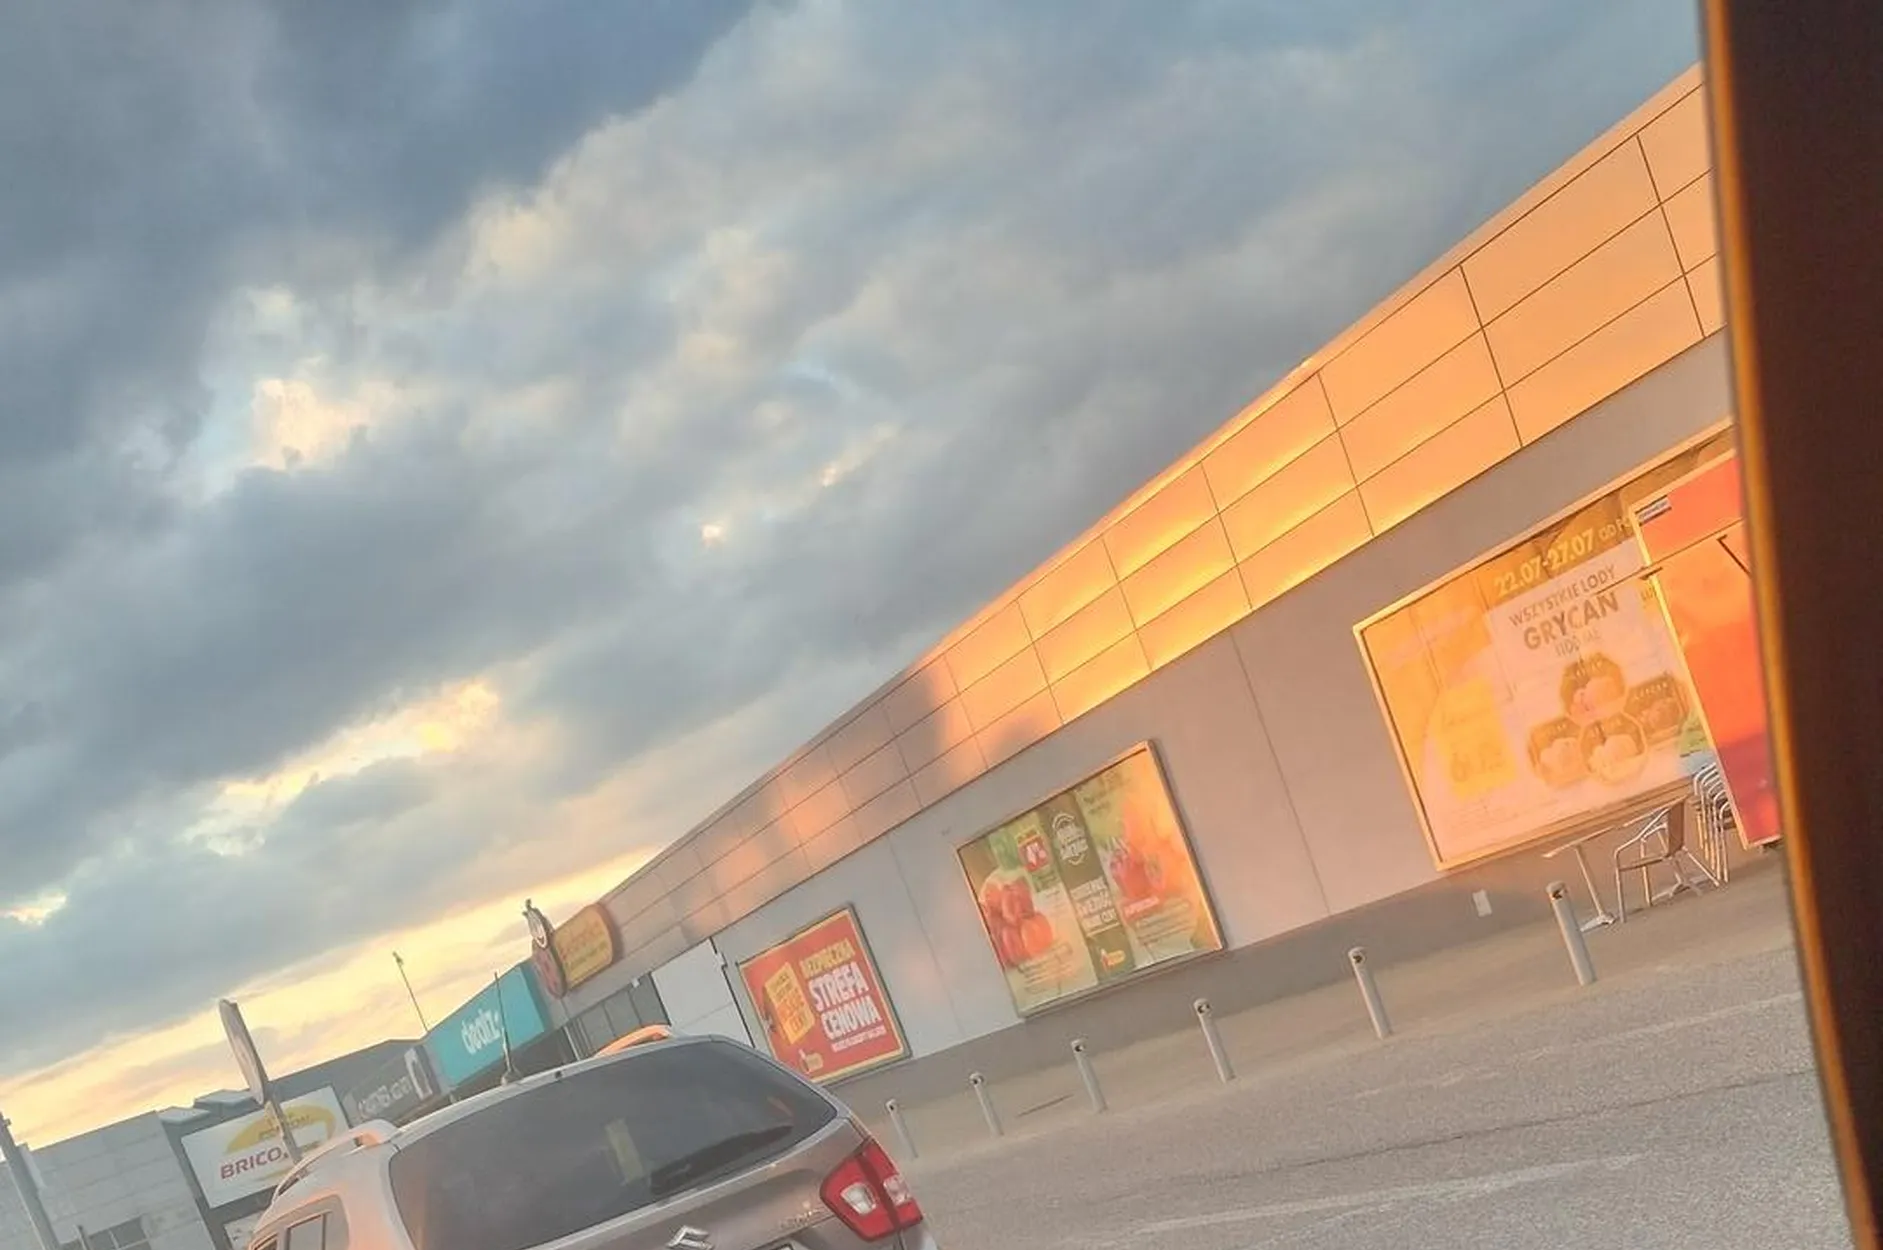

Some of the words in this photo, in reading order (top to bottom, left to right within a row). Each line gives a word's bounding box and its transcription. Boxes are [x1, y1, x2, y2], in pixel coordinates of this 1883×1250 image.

[1494, 528, 1595, 595] 22.07-27.07
[1508, 583, 1579, 628] WSZYSTKIE
[1578, 563, 1616, 595] LODY
[1522, 590, 1620, 651] GRYCAN
[808, 961, 870, 1013] STREFA
[820, 994, 883, 1041] CENOWA
[219, 1145, 290, 1181] BRICO
